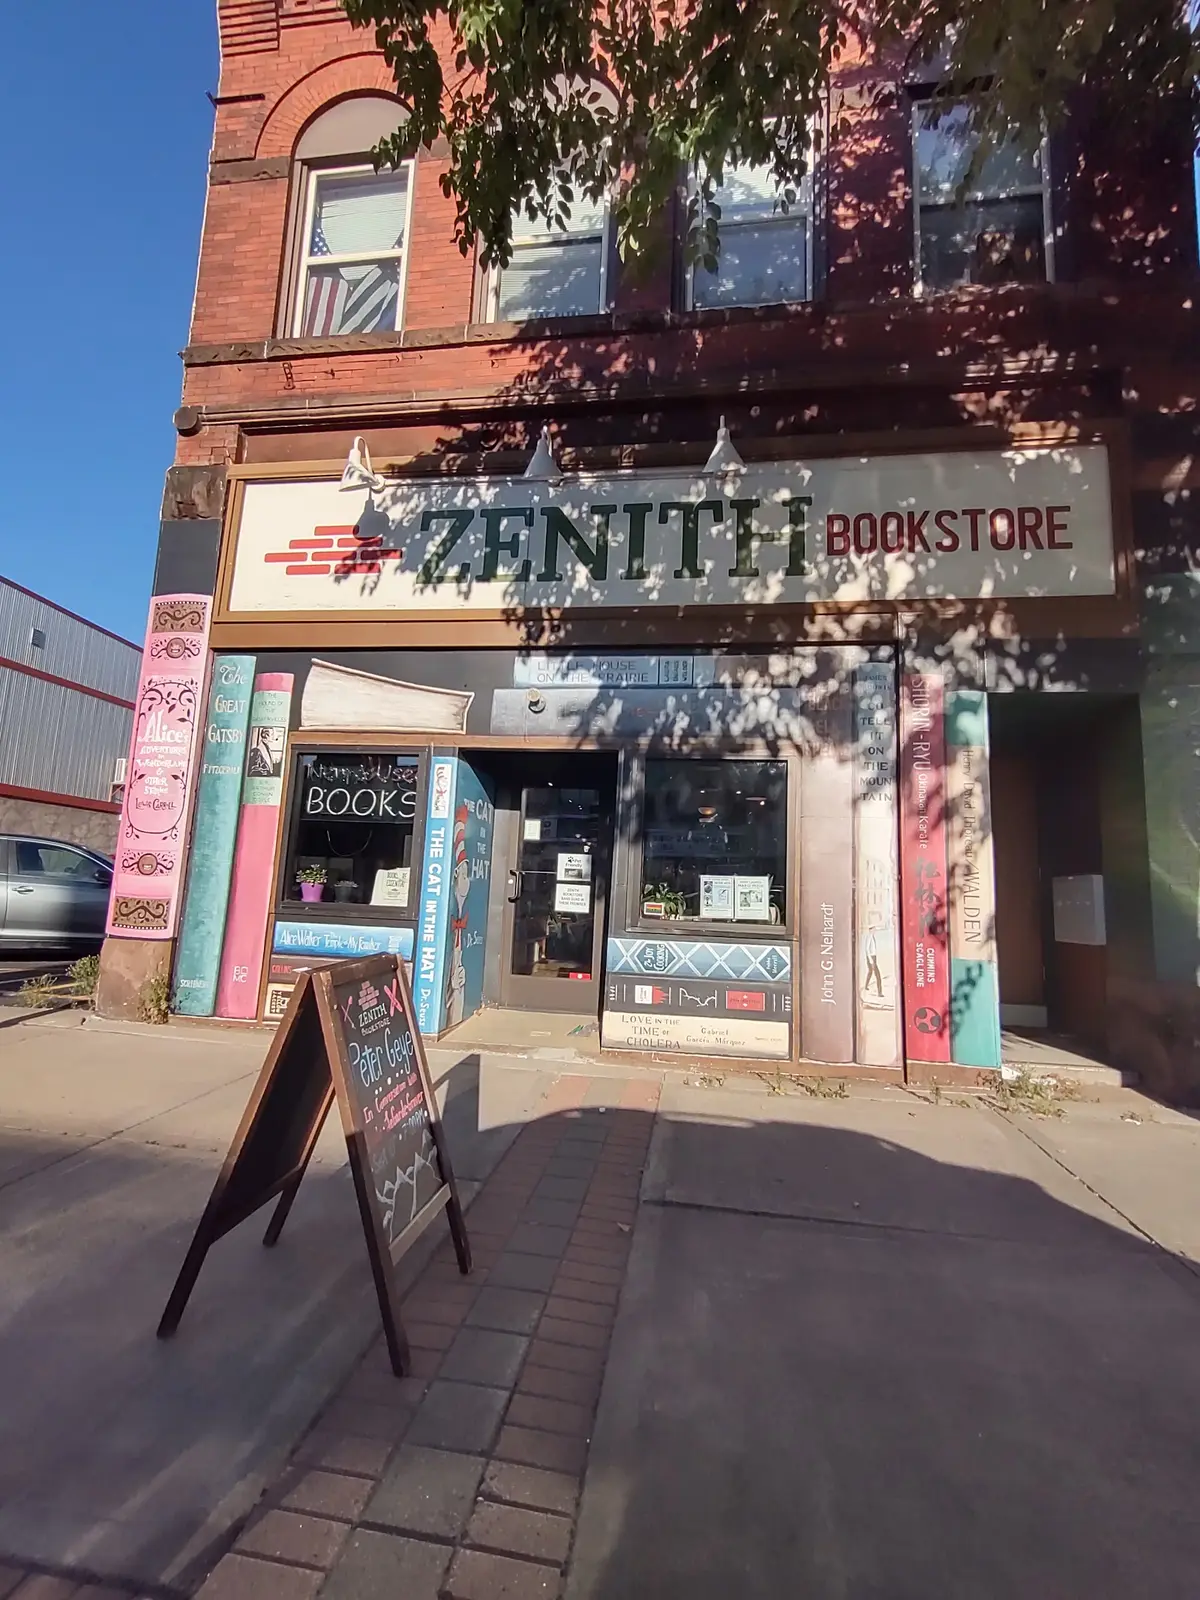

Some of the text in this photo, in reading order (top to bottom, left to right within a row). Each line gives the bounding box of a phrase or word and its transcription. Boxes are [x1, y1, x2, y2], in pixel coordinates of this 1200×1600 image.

[416, 497, 1073, 585] ZENITH BOOKSTORE
[220, 665, 247, 684] The
[537, 672, 554, 683] ON
[215, 694, 246, 713] GREAT
[137, 709, 189, 743] Alice's
[208, 724, 244, 744] GATSBY
[868, 747, 884, 755] ON
[864, 761, 888, 771] THE
[962, 750, 974, 777] Henry
[307, 786, 417, 818] BOOKS
[476, 799, 494, 824] CAT
[918, 815, 930, 849] Karate
[471, 858, 490, 880] HAT
[420, 827, 446, 982] THE CAT IN THE HAT
[963, 870, 982, 944] WALDEN
[279, 930, 298, 946] Alice
[297, 929, 322, 947] Walker
[820, 902, 837, 1005] John G. Neihardt
[916, 942, 925, 988] SCAGLIONE
[927, 948, 935, 983] CUMMINS
[358, 1003, 387, 1027] ZENITH
[622, 1014, 651, 1025] LOVE
[662, 1018, 681, 1026] THE
[361, 1017, 391, 1036] BOOKSTORE
[632, 1026, 659, 1036] TIME
[701, 1027, 729, 1036] Gabriel
[626, 1036, 681, 1049] CHOLERA
[349, 1027, 413, 1087] Peter Geye
[363, 1106, 374, 1124] In
